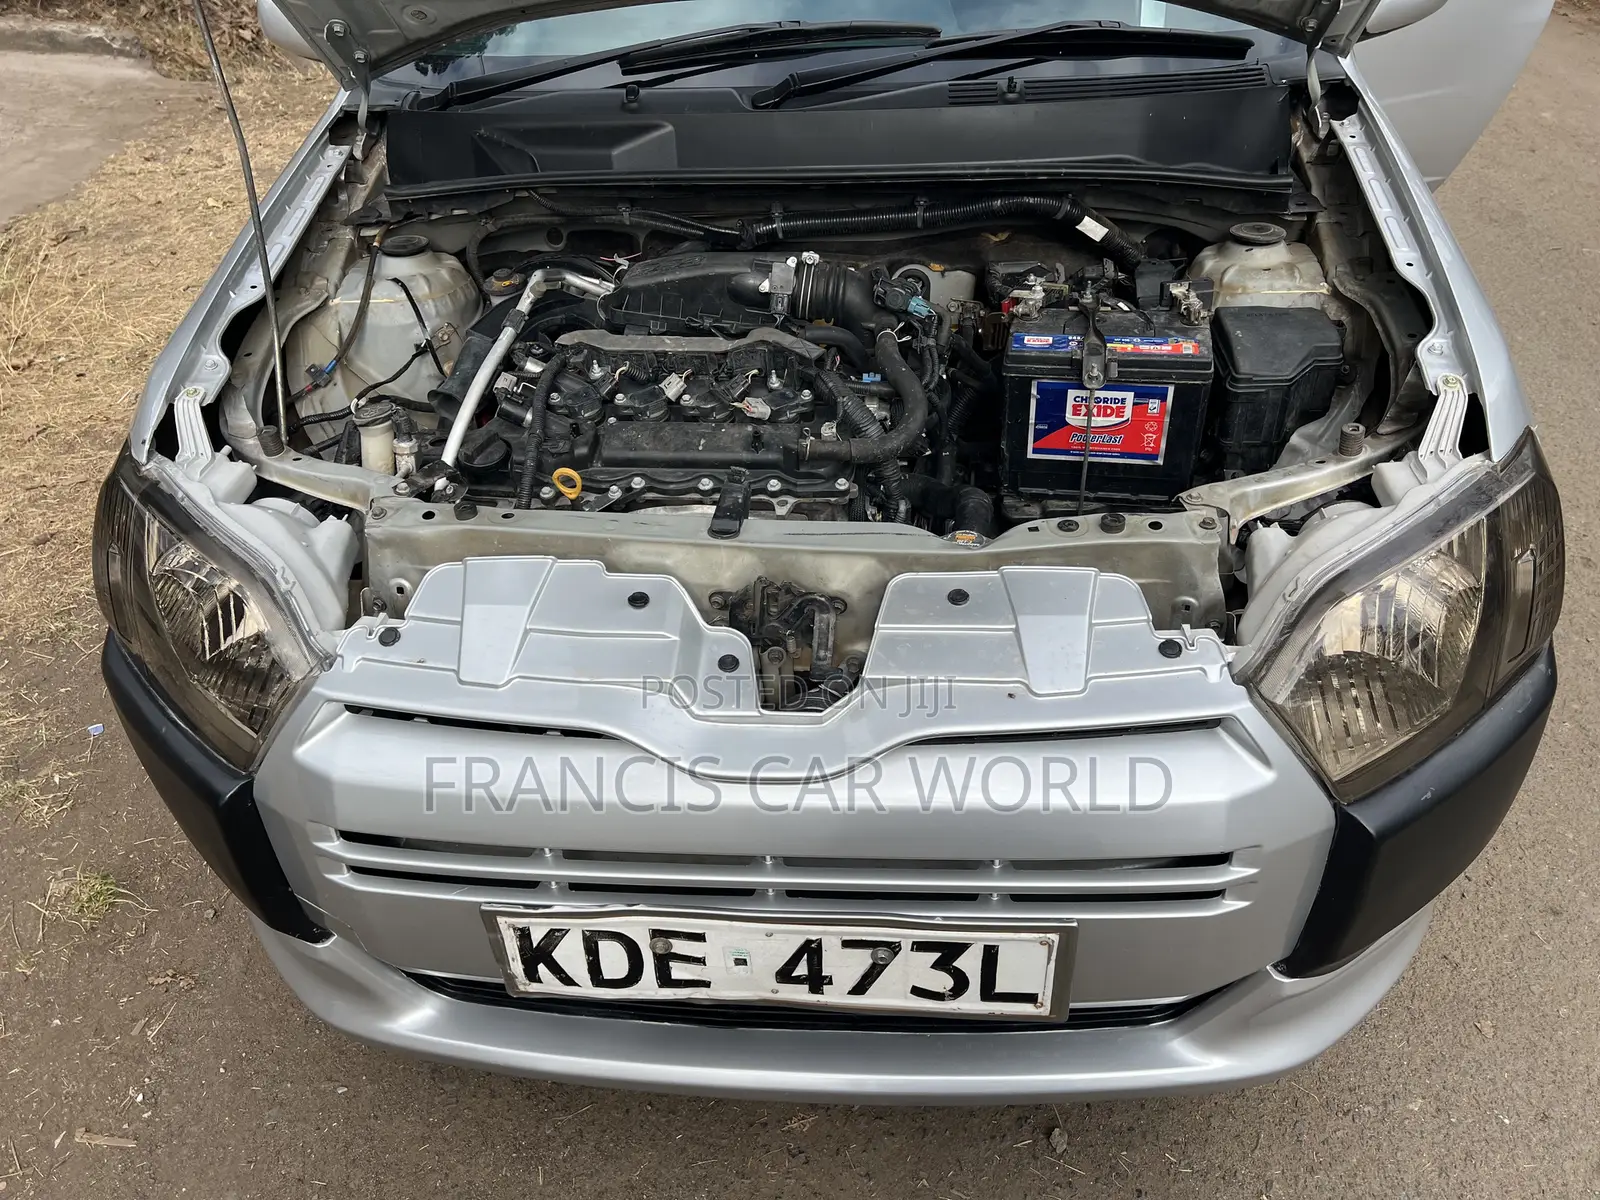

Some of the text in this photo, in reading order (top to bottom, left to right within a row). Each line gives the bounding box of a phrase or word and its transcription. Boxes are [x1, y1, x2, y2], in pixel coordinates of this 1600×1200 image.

[1073, 395, 1127, 405] CHORIDE
[1071, 403, 1127, 418] EXIDE
[514, 926, 1040, 1005] KDE 473L
